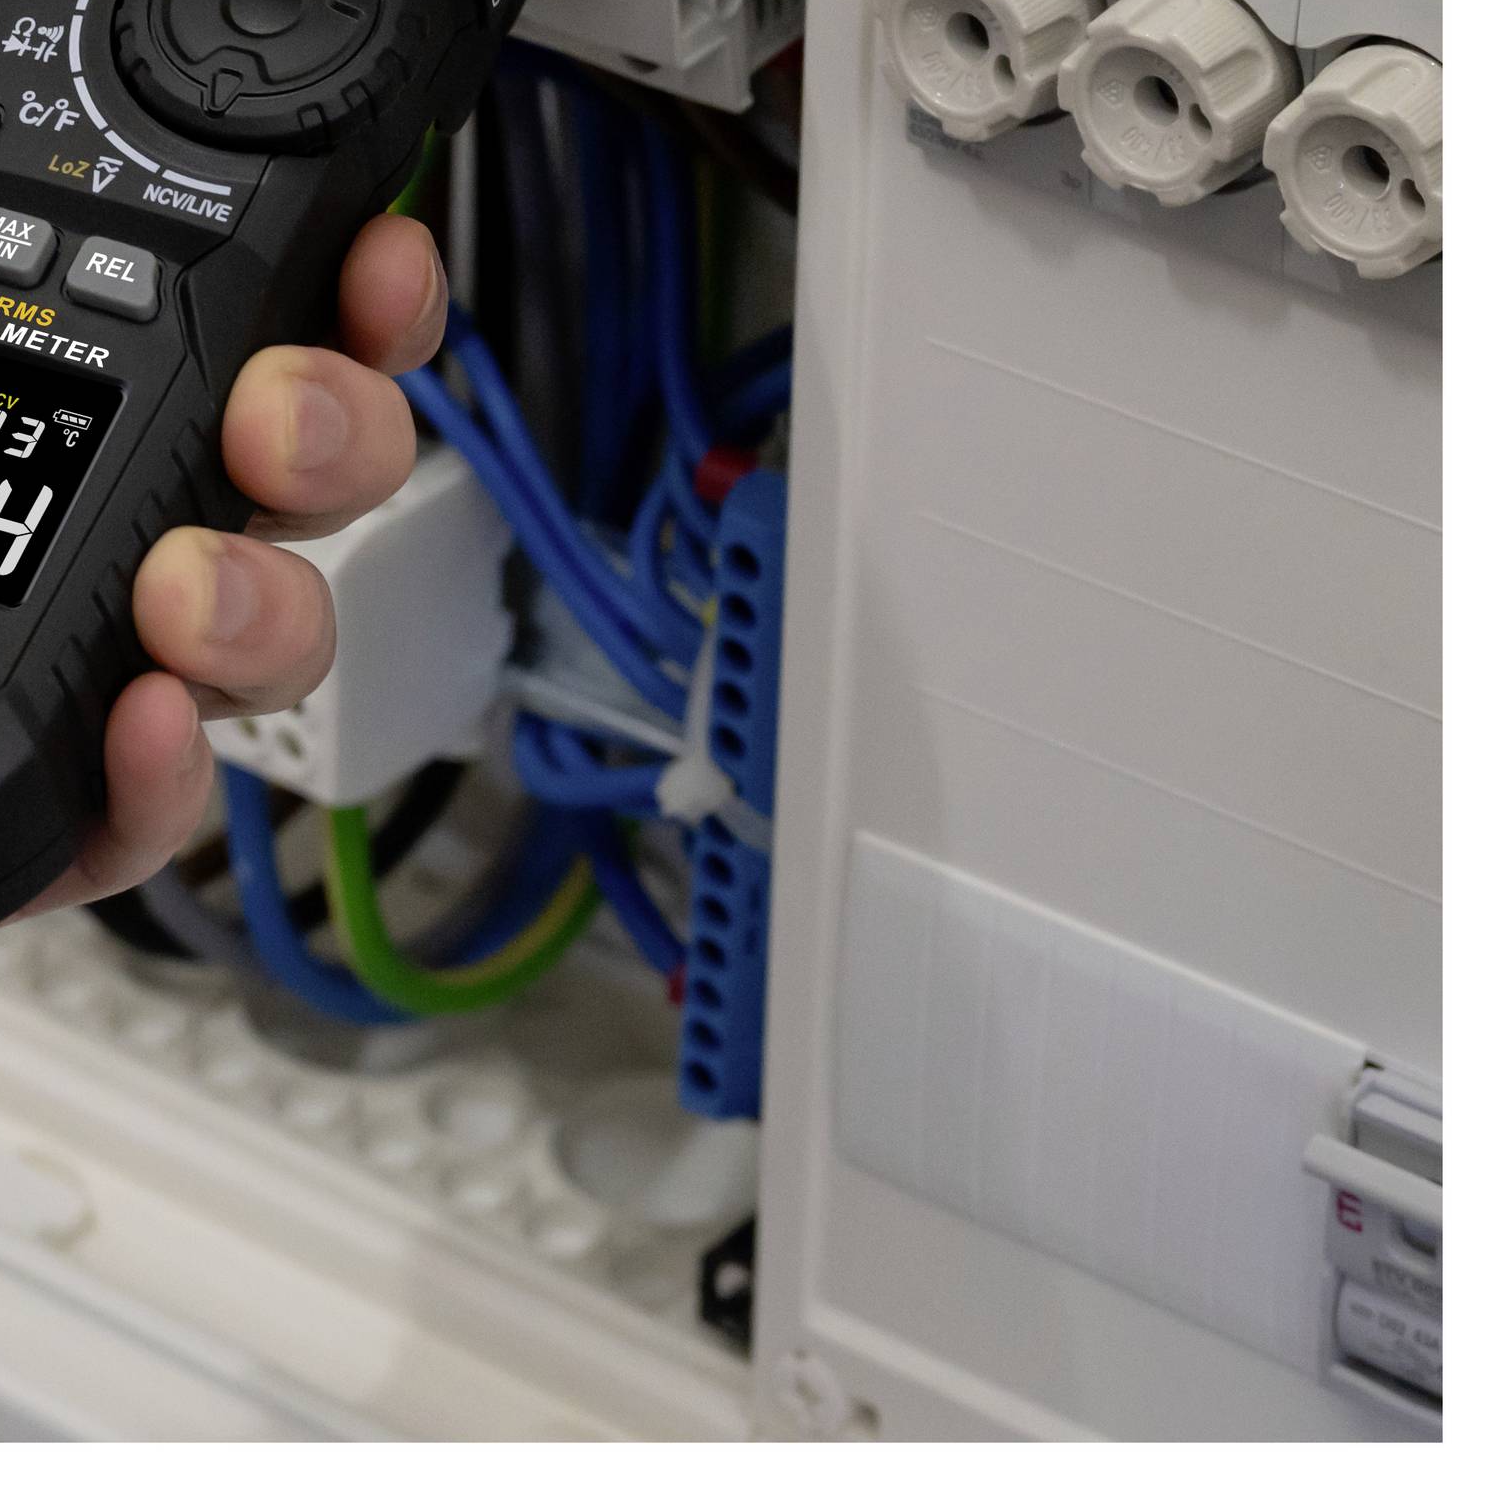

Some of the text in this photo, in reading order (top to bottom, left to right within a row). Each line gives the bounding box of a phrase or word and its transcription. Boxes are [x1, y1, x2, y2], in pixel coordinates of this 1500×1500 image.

[47, 154, 91, 179] LoZ
[143, 184, 233, 222] NCV/LIVE
[85, 252, 137, 283] REL
[0, 321, 111, 369] METER
